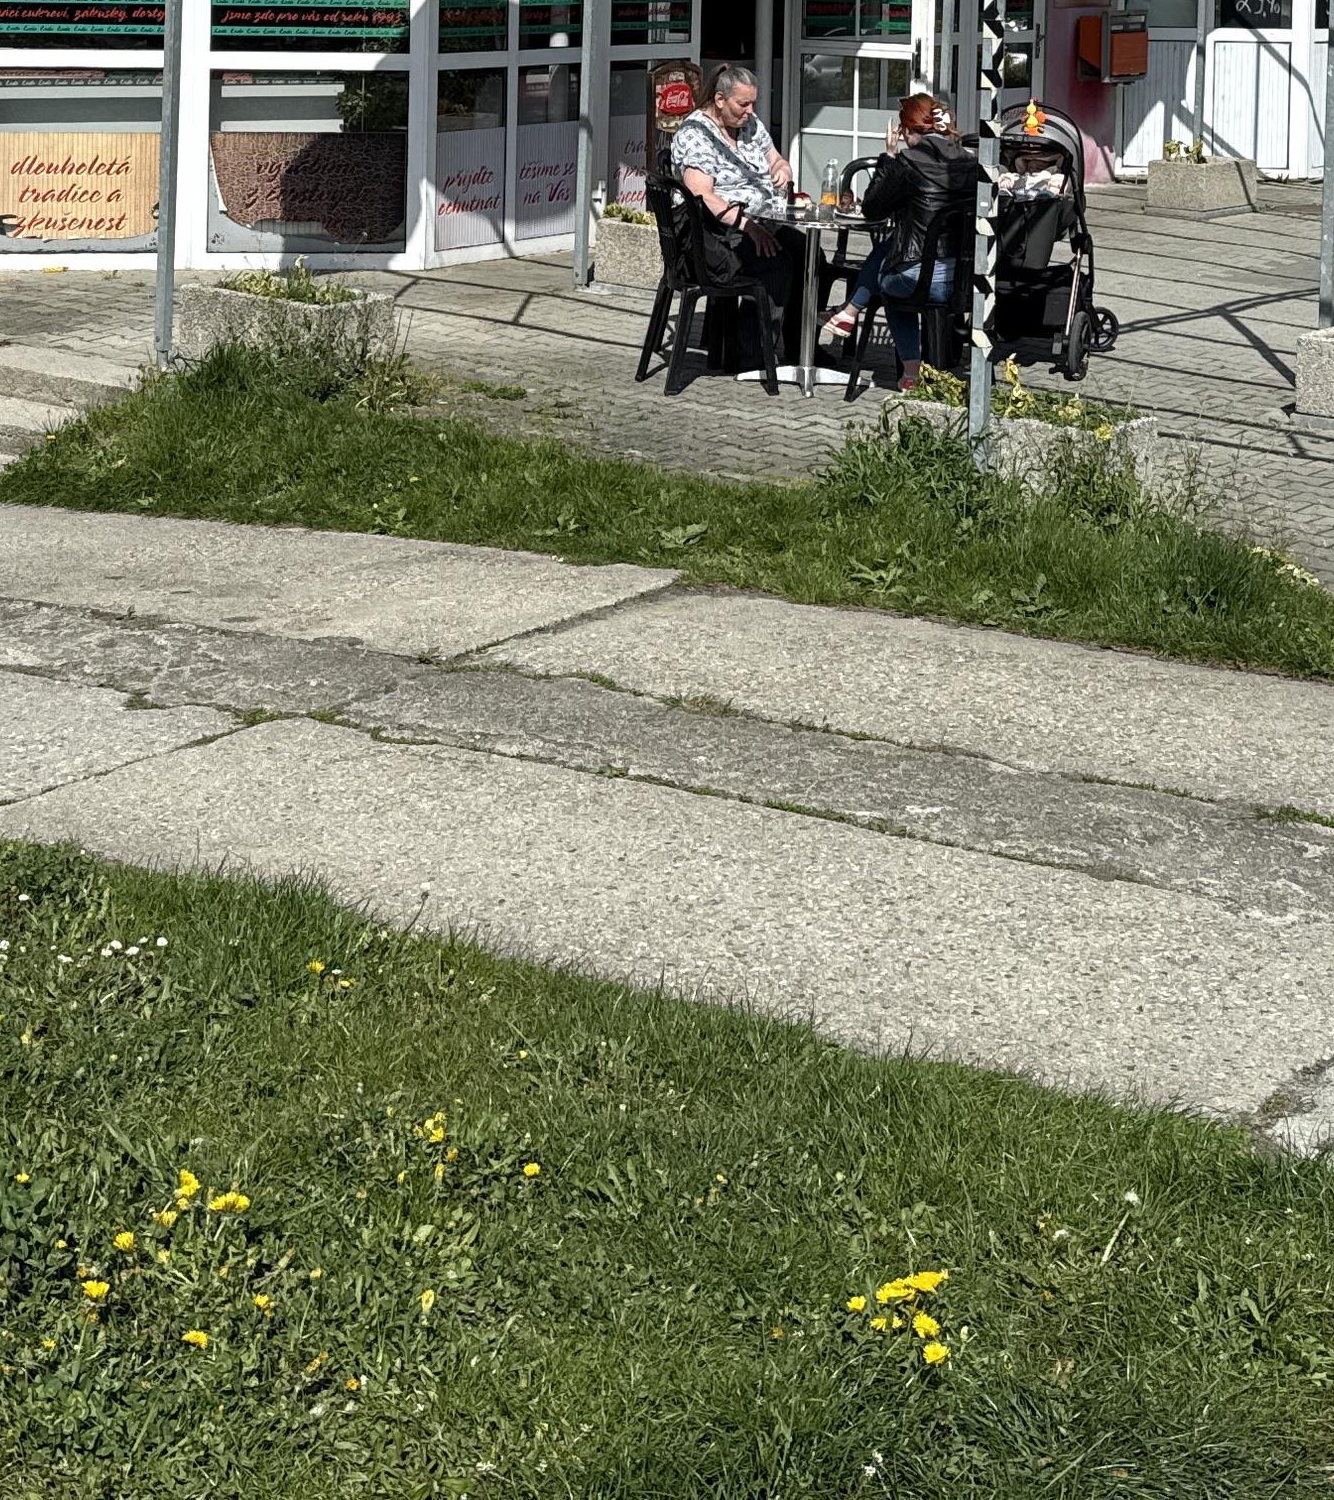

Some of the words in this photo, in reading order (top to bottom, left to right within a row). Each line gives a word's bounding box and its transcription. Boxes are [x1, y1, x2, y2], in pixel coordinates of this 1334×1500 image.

[275, 11, 299, 24] pro
[10, 154, 134, 176] dlouholetá
[18, 183, 103, 204] tradice
[106, 188, 124, 204] a
[523, 190, 541, 205] na
[11, 212, 130, 239] zkušenost
